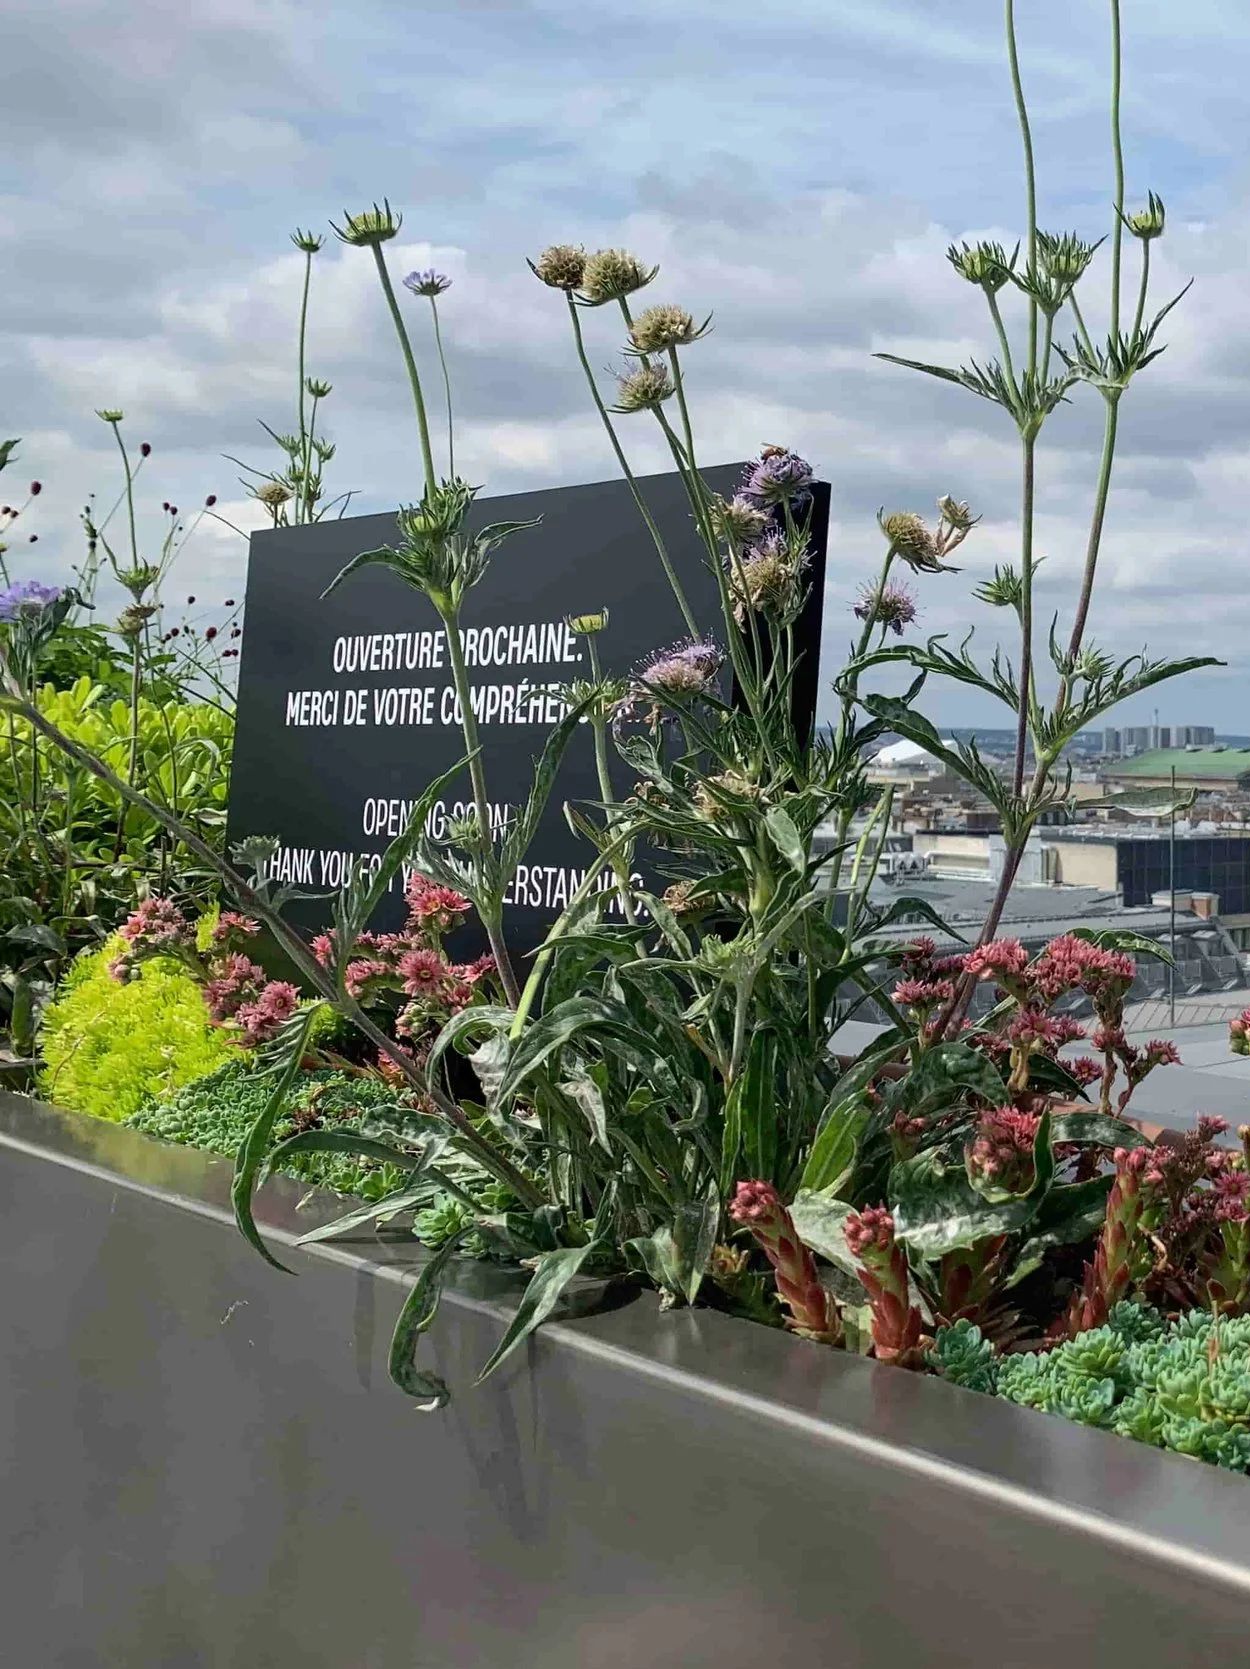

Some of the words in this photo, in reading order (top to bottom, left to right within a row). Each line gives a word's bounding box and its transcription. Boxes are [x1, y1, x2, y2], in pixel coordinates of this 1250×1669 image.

[333, 631, 445, 673] OUVERTURE
[286, 690, 339, 727] MERCI
[343, 689, 368, 726] DE
[374, 687, 435, 726] VOTRE
[263, 846, 315, 885] HANK
[320, 850, 354, 888] YOU
